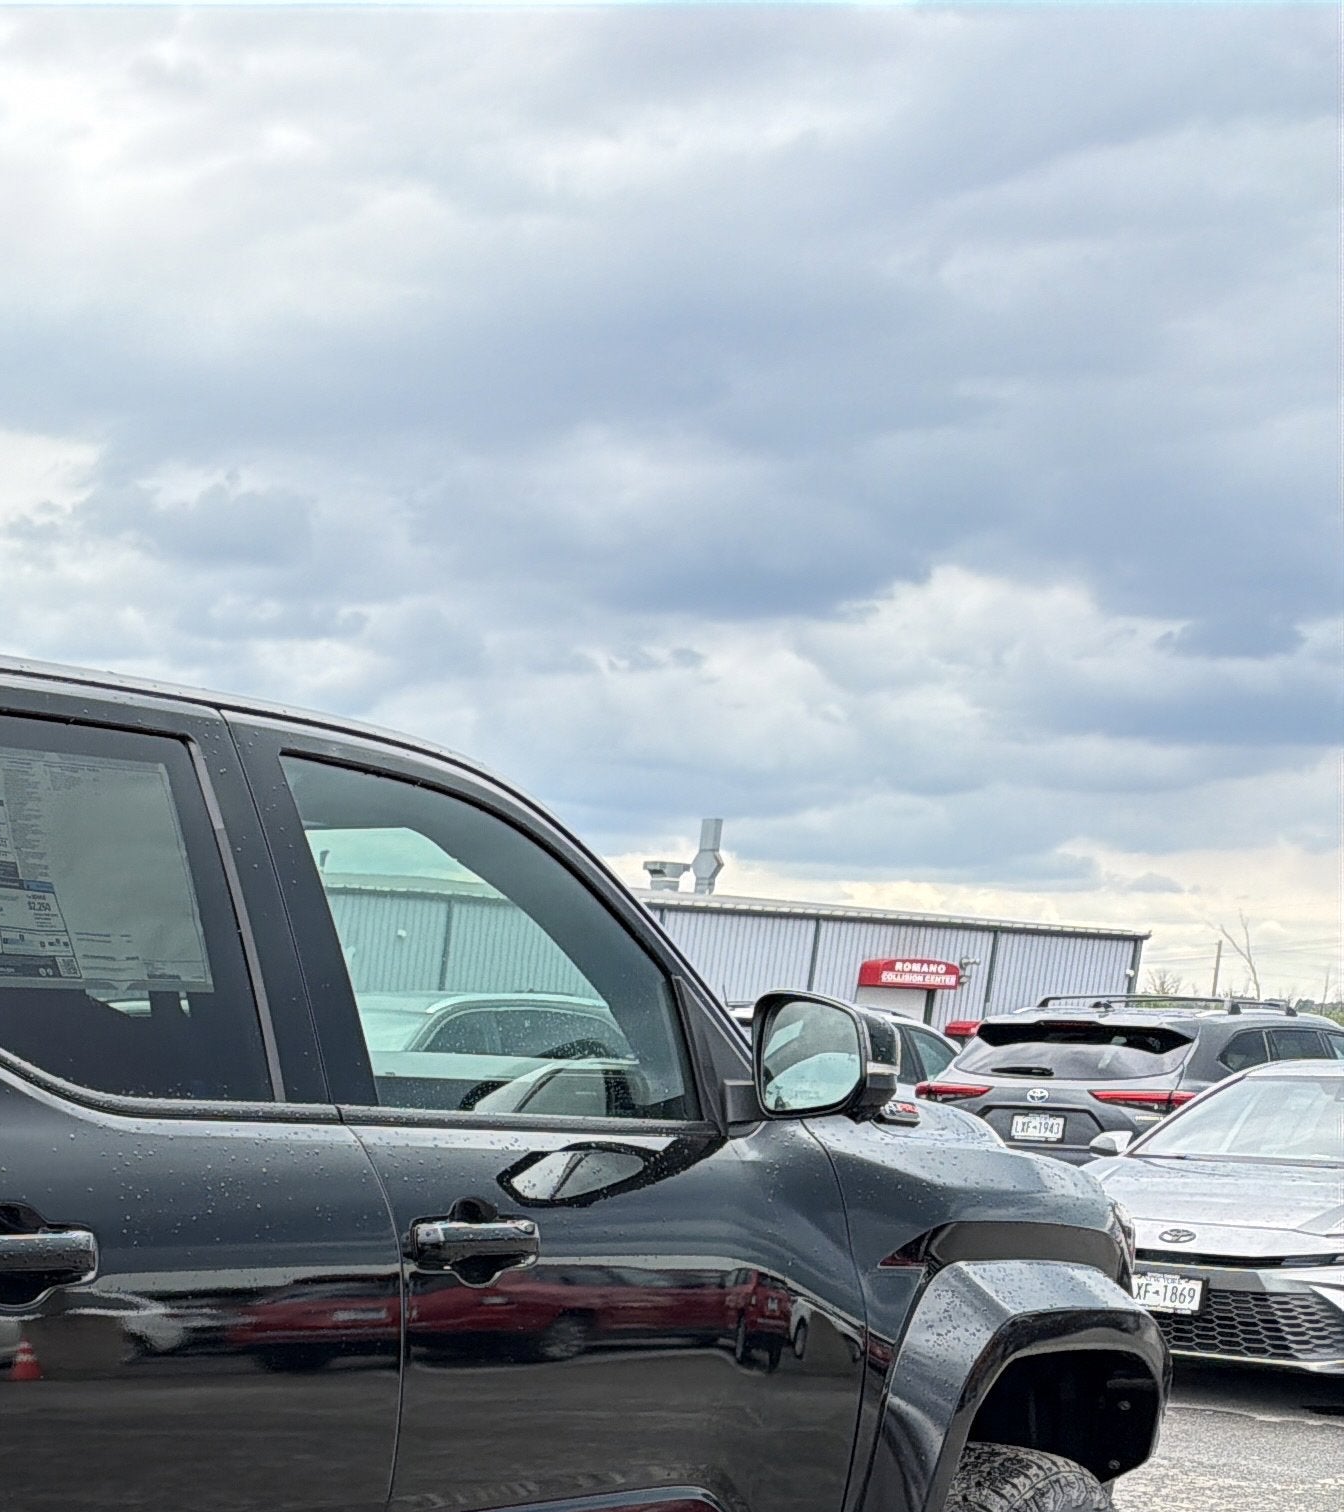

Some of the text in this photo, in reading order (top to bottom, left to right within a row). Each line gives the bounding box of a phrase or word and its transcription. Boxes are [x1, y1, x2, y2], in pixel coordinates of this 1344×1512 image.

[894, 962, 947, 974] ROMANO
[881, 971, 957, 986] COLLISION CENTER
[1132, 1282, 1196, 1305] XF-1869
